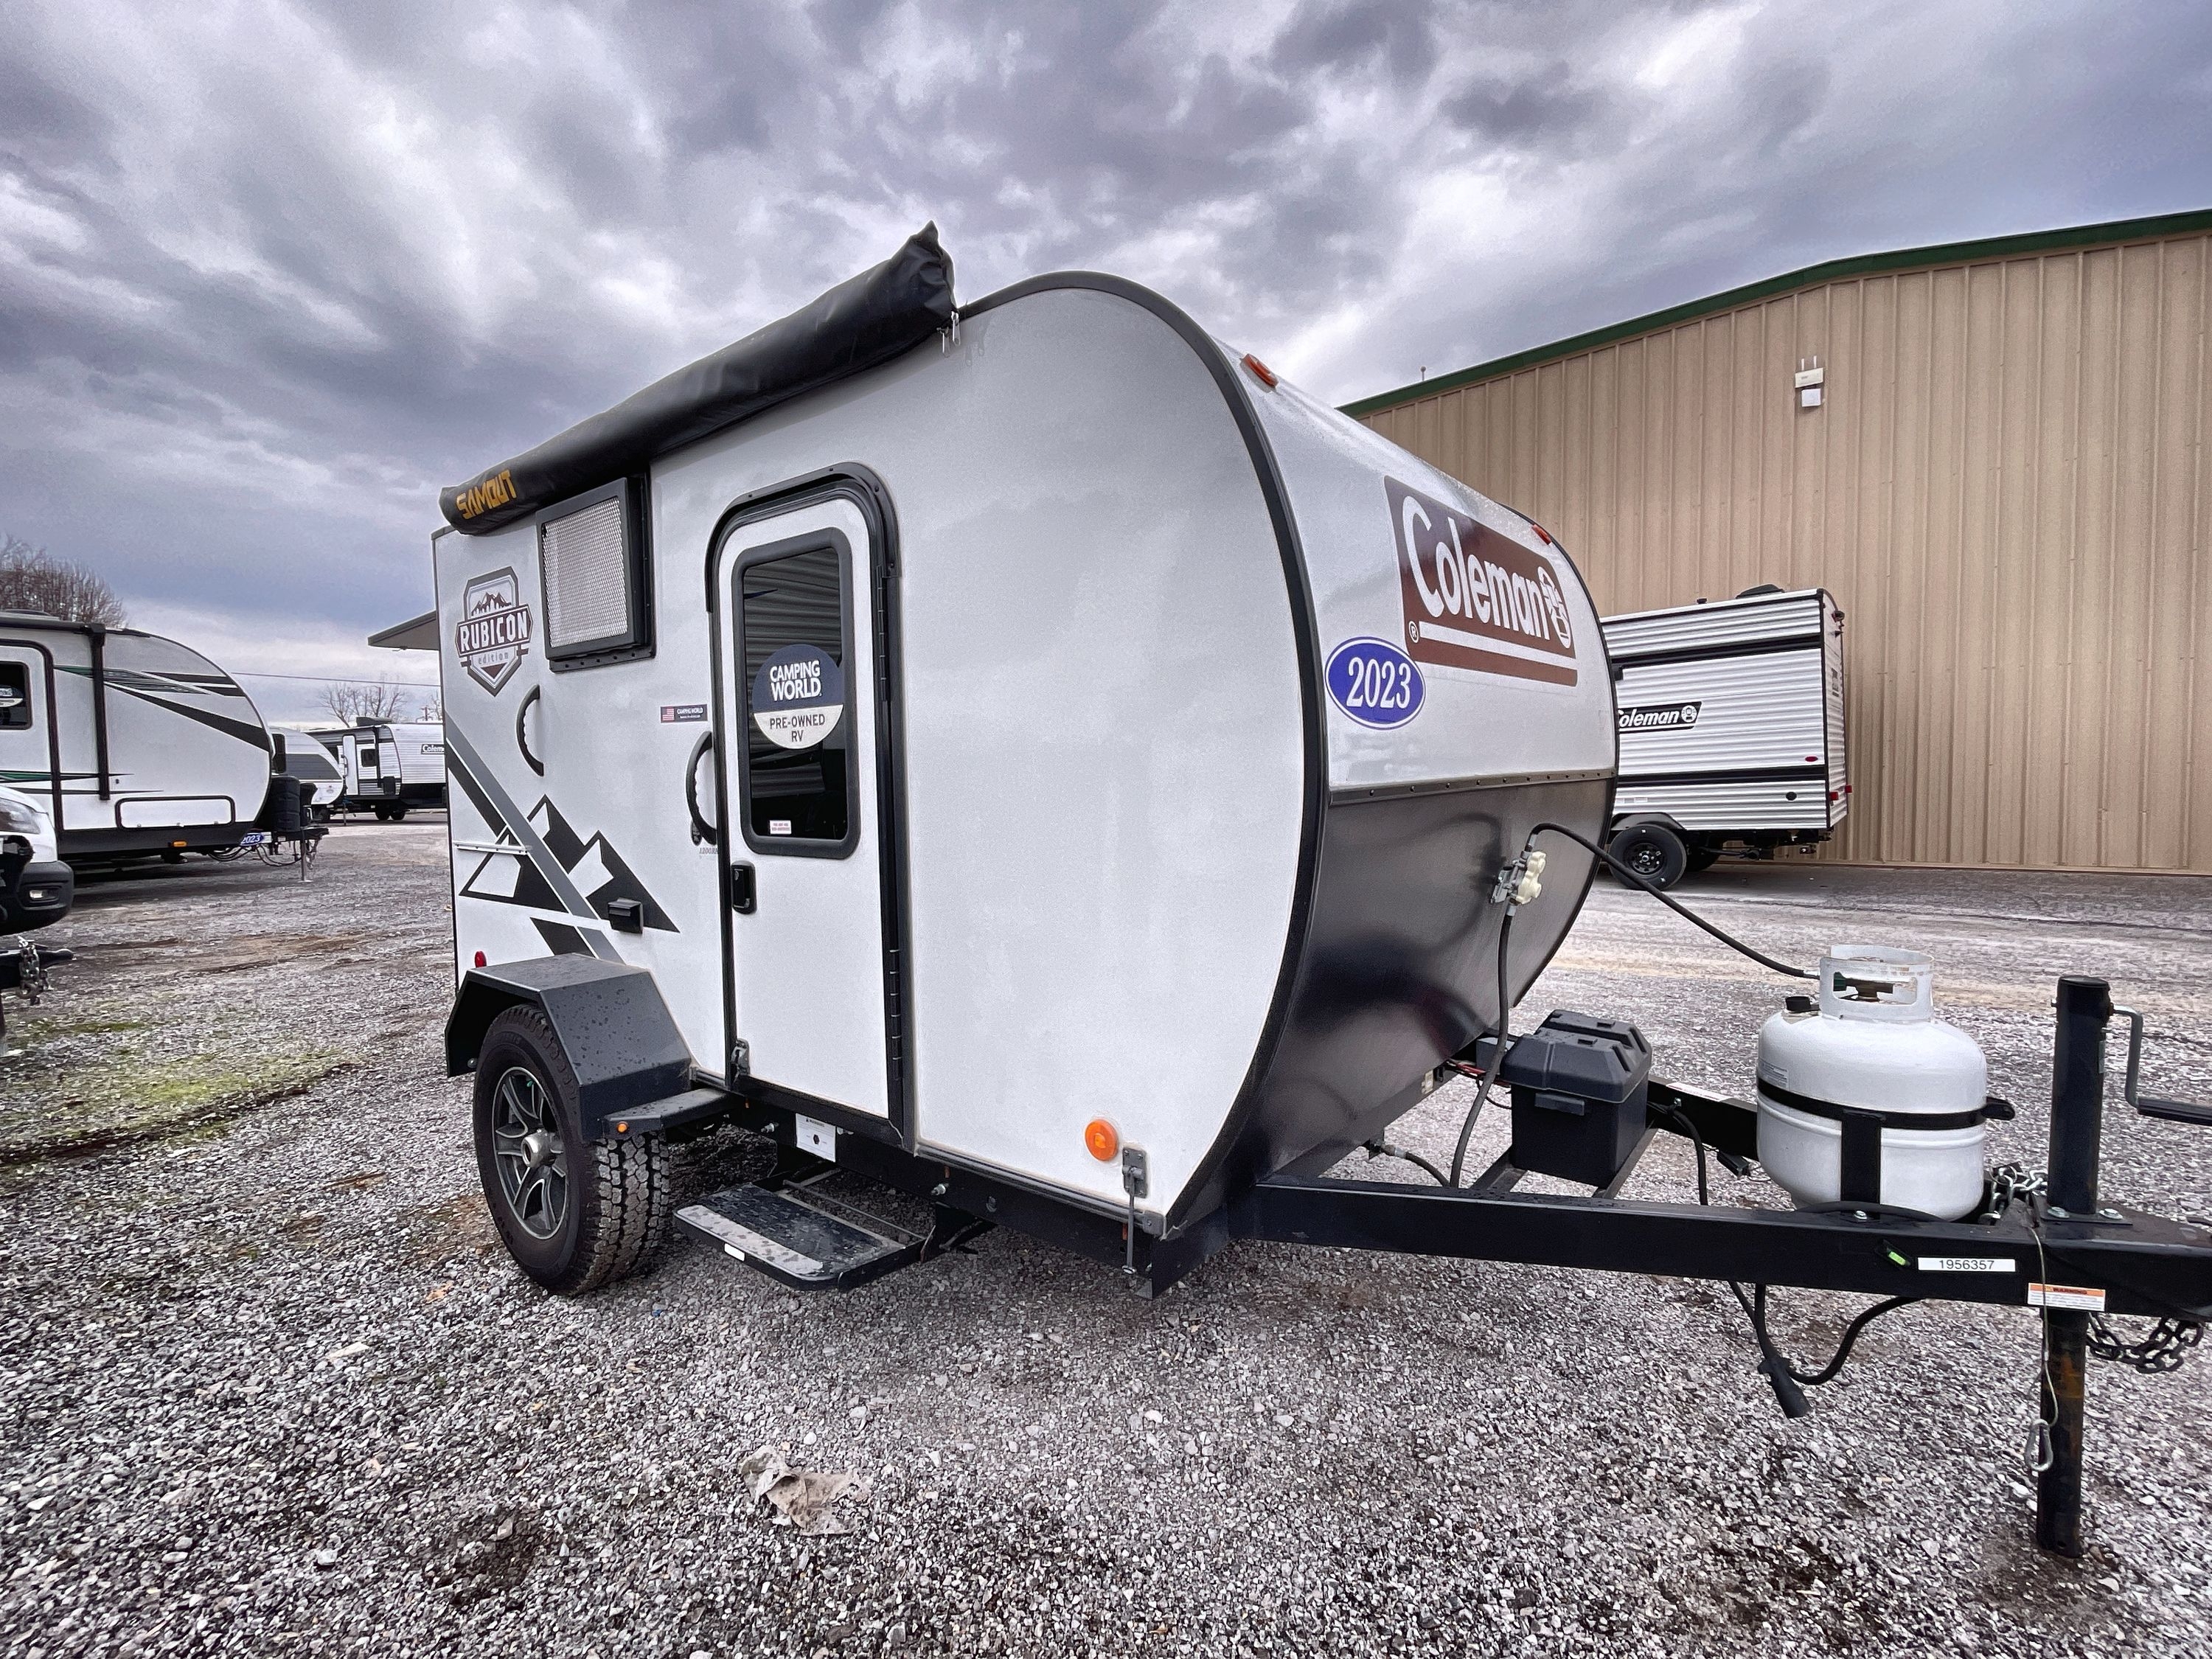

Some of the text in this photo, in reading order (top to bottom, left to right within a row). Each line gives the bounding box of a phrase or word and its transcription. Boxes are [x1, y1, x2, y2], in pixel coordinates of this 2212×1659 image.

[1402, 495, 1550, 641] Coleman
[459, 611, 528, 652] RUBICON
[478, 652, 509, 664] edition
[770, 660, 821, 682] CAMPING
[771, 678, 822, 701] WORLD
[1346, 657, 1411, 709] 2023
[769, 714, 825, 729] PRE-OWNED
[1618, 709, 1680, 727] oleman
[791, 730, 804, 742] RV
[422, 744, 445, 752] Colem
[1938, 1259, 1994, 1270] 1956357
